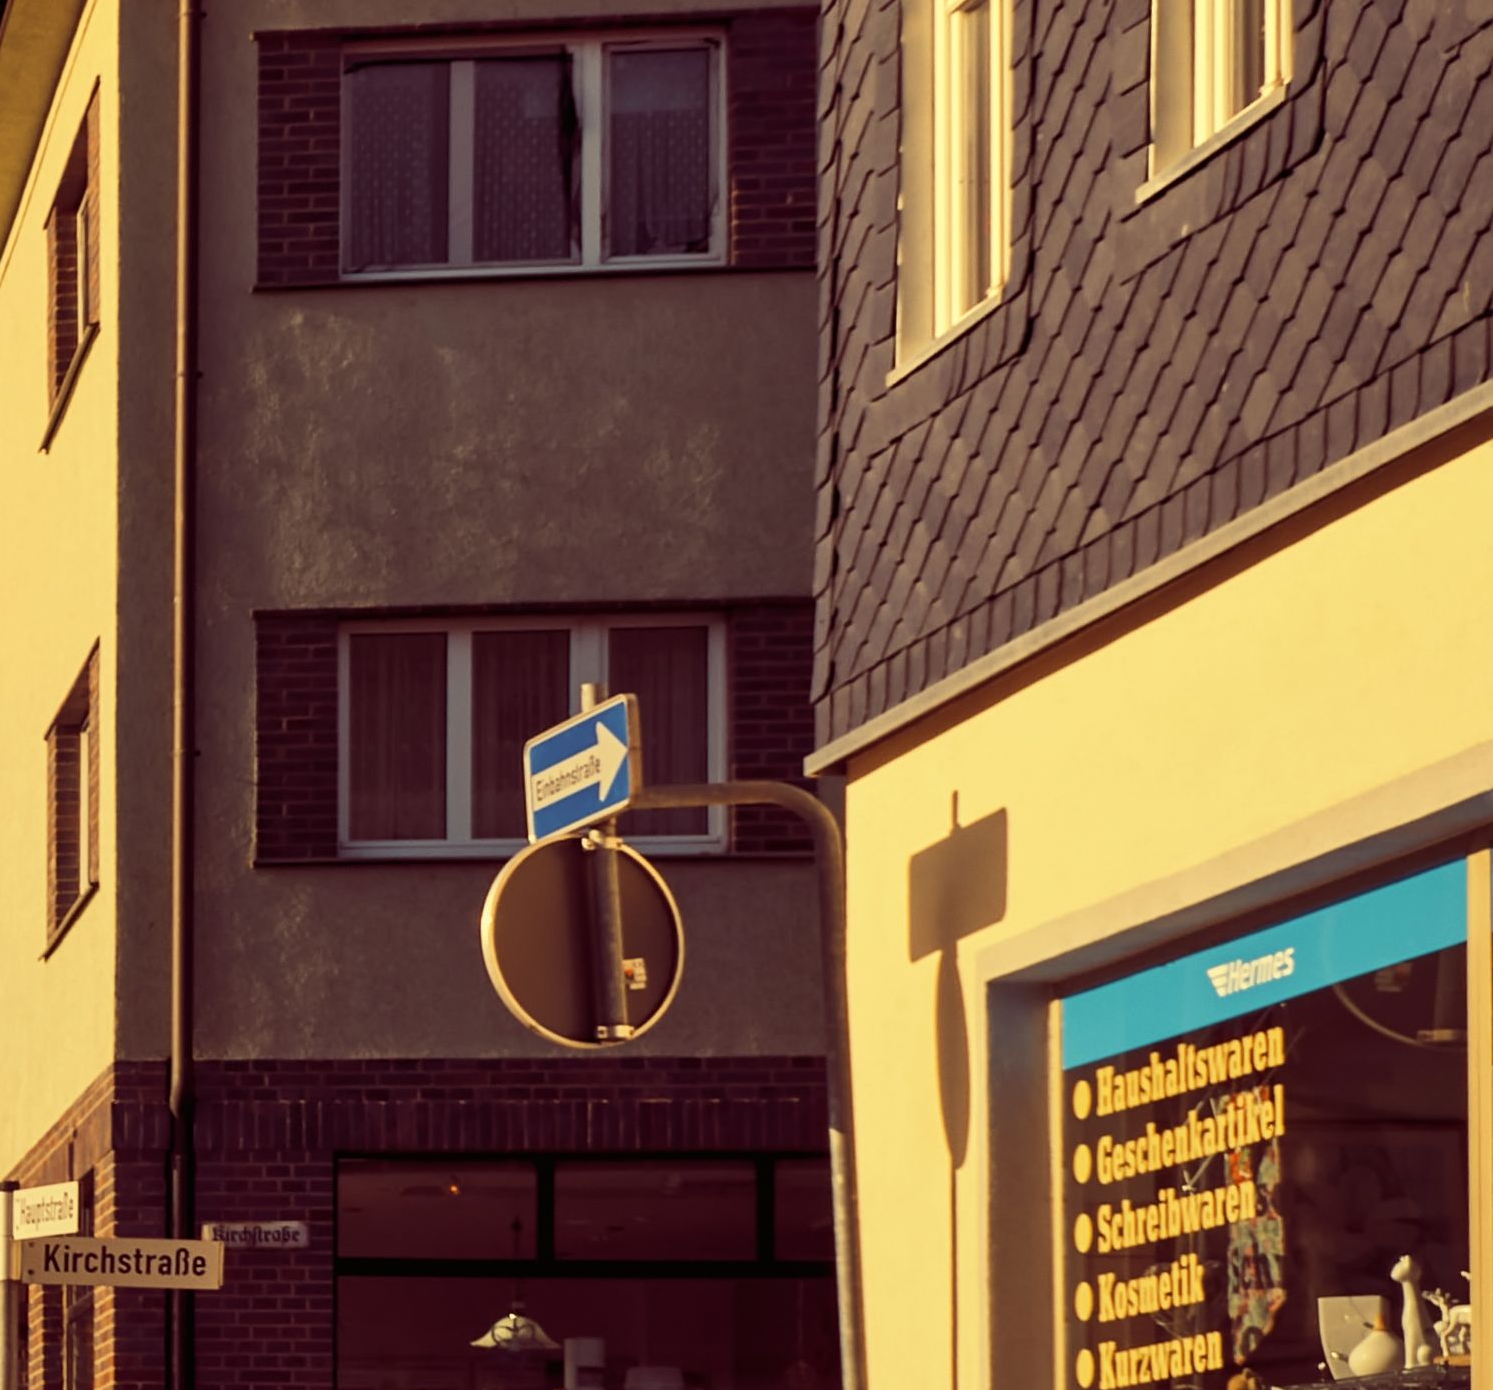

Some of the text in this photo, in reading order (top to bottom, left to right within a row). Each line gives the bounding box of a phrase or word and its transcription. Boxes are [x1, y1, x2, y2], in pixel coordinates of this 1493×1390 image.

[1227, 947, 1295, 994] Hermes
[1096, 1026, 1286, 1117] Haushaltswaren
[1096, 1084, 1285, 1185] Geschenkartikel
[20, 1191, 74, 1231] Hauptstraße
[1097, 1180, 1257, 1254] Schreibwaren
[43, 1243, 207, 1277] Kirchstraße
[1098, 1252, 1205, 1323] Kosmetik
[1098, 1331, 1223, 1390] Kurzwaren
